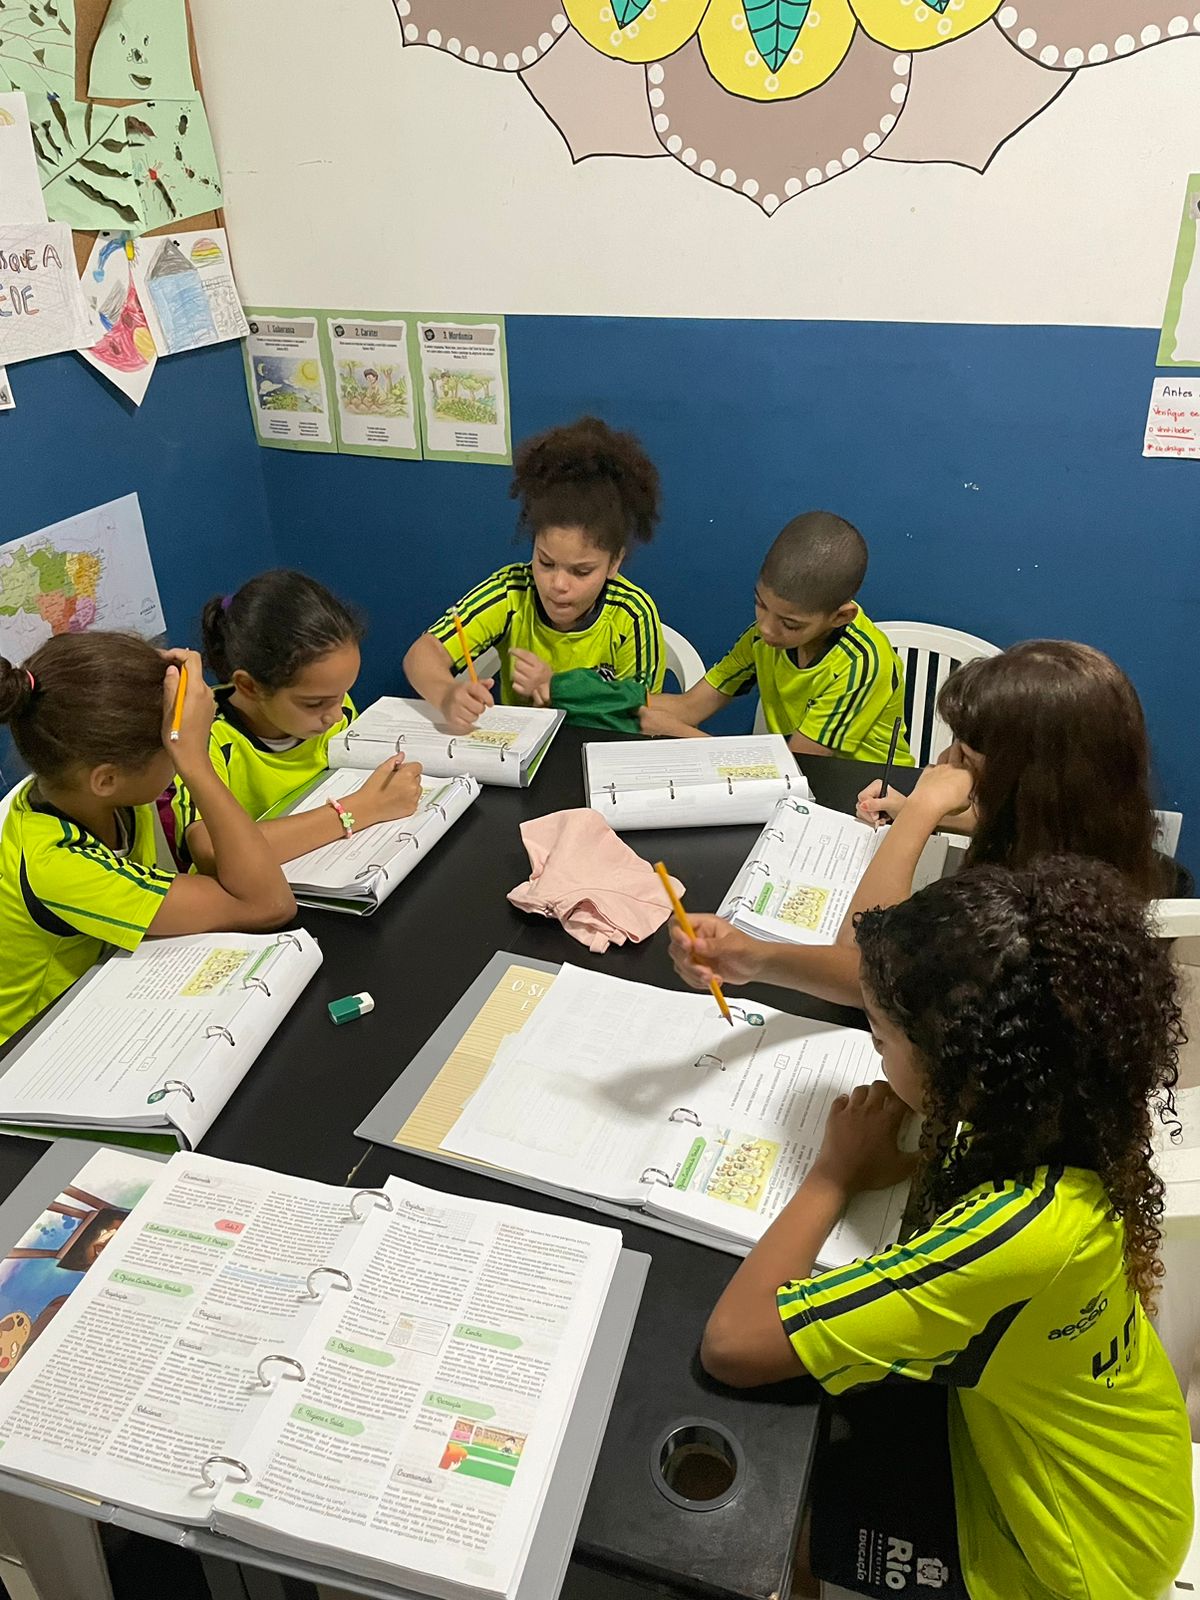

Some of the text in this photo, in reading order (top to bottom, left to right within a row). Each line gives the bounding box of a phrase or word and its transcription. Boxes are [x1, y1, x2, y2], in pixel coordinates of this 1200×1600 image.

[43, 244, 63, 269] A
[1162, 386, 1192, 398] Antes
[511, 979, 524, 991] O
[395, 1468, 433, 1483] Encerramento
[857, 1528, 868, 1580] EDUCAÇÃO
